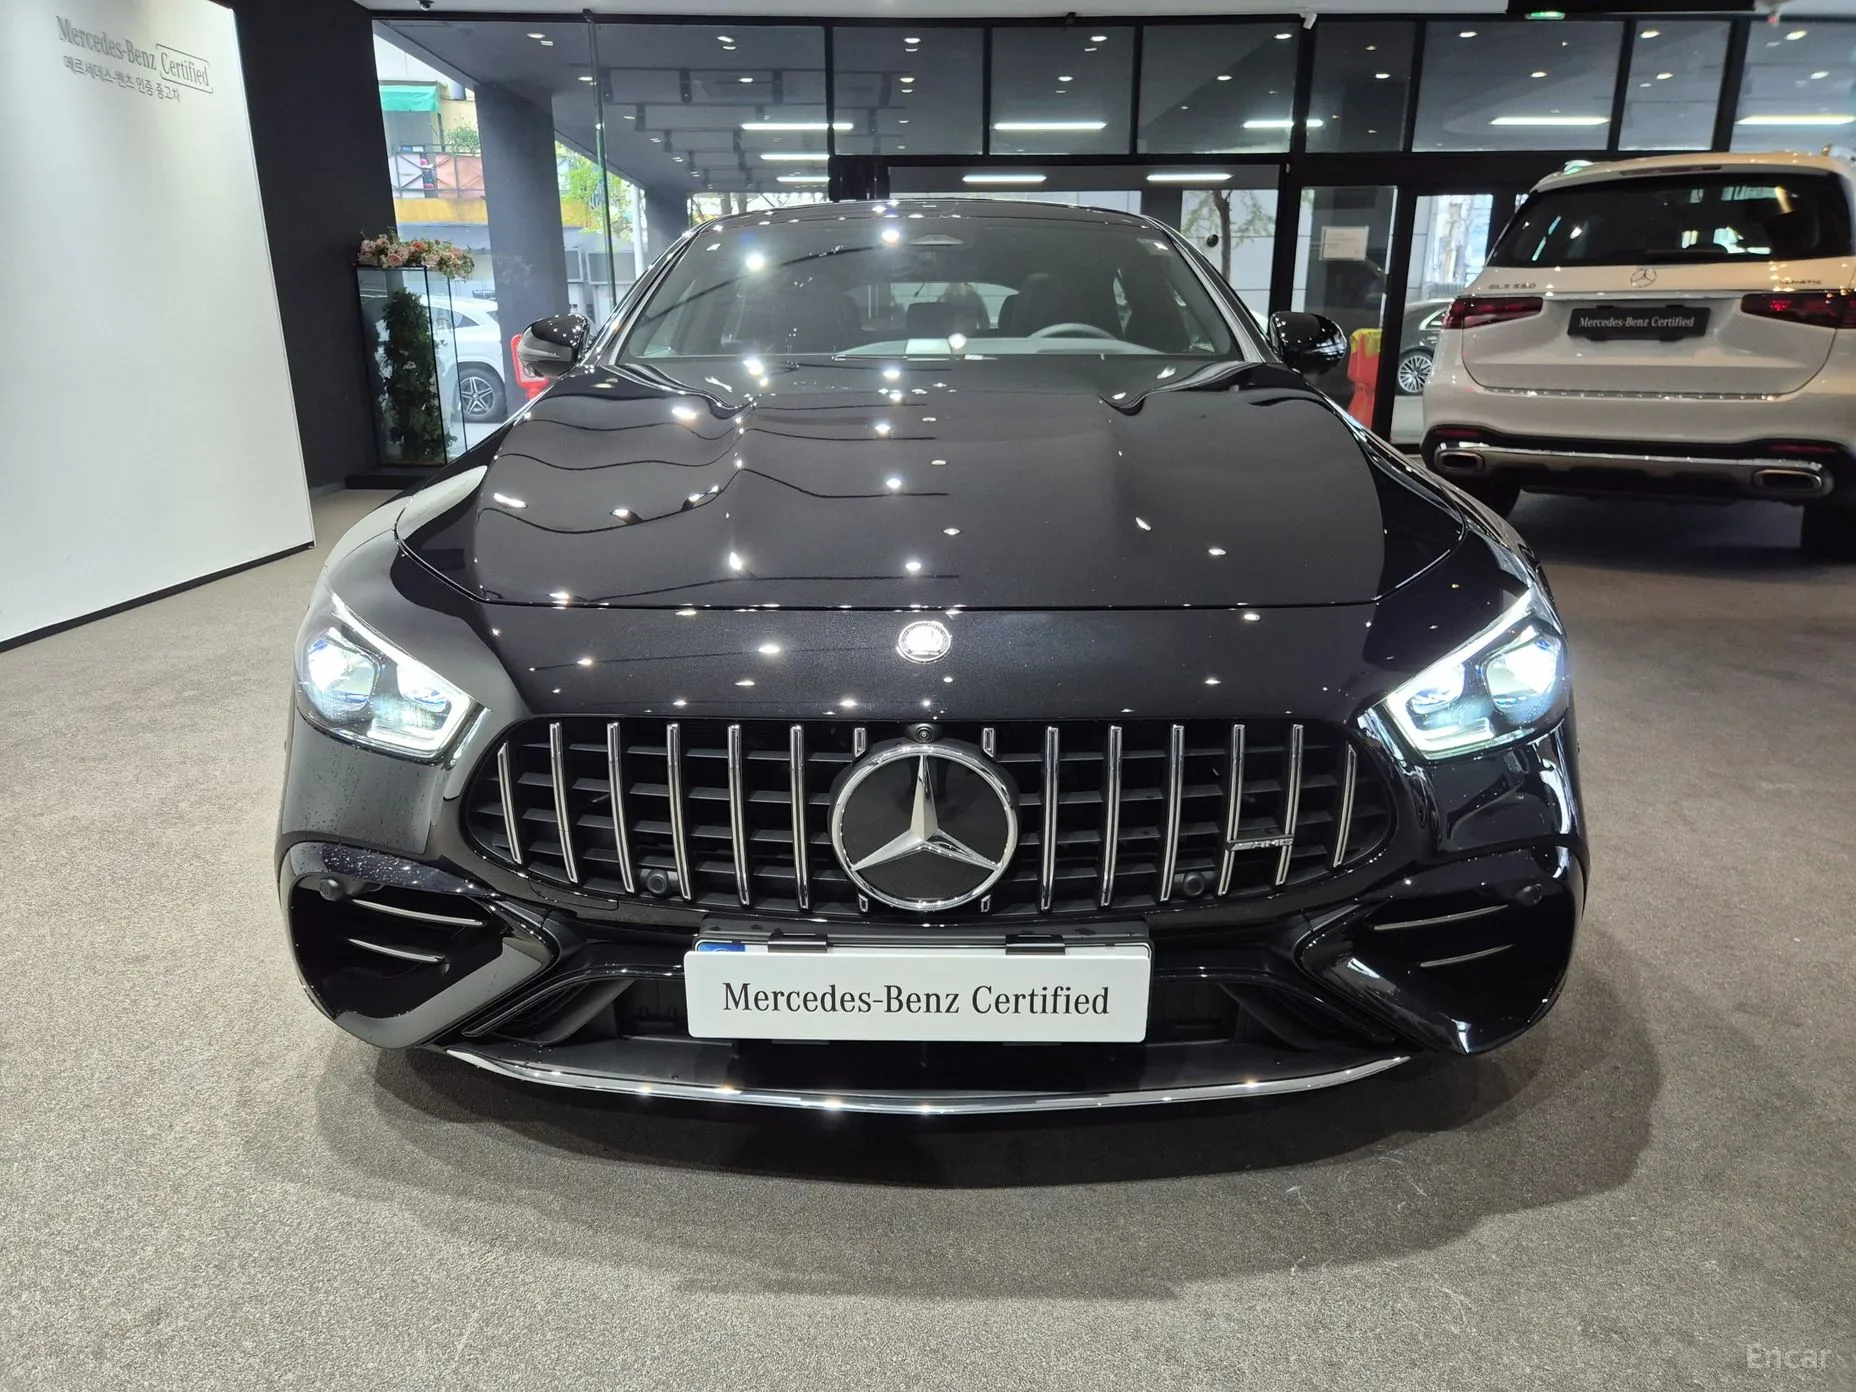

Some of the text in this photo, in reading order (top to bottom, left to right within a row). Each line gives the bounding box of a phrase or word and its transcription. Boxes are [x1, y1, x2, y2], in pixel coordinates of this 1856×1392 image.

[56, 15, 209, 87] Mercedes-Benz Certified
[1579, 316, 1695, 328] Mercedes-Benz Certified
[722, 982, 1110, 1015] Mercedes-Benz Certified
